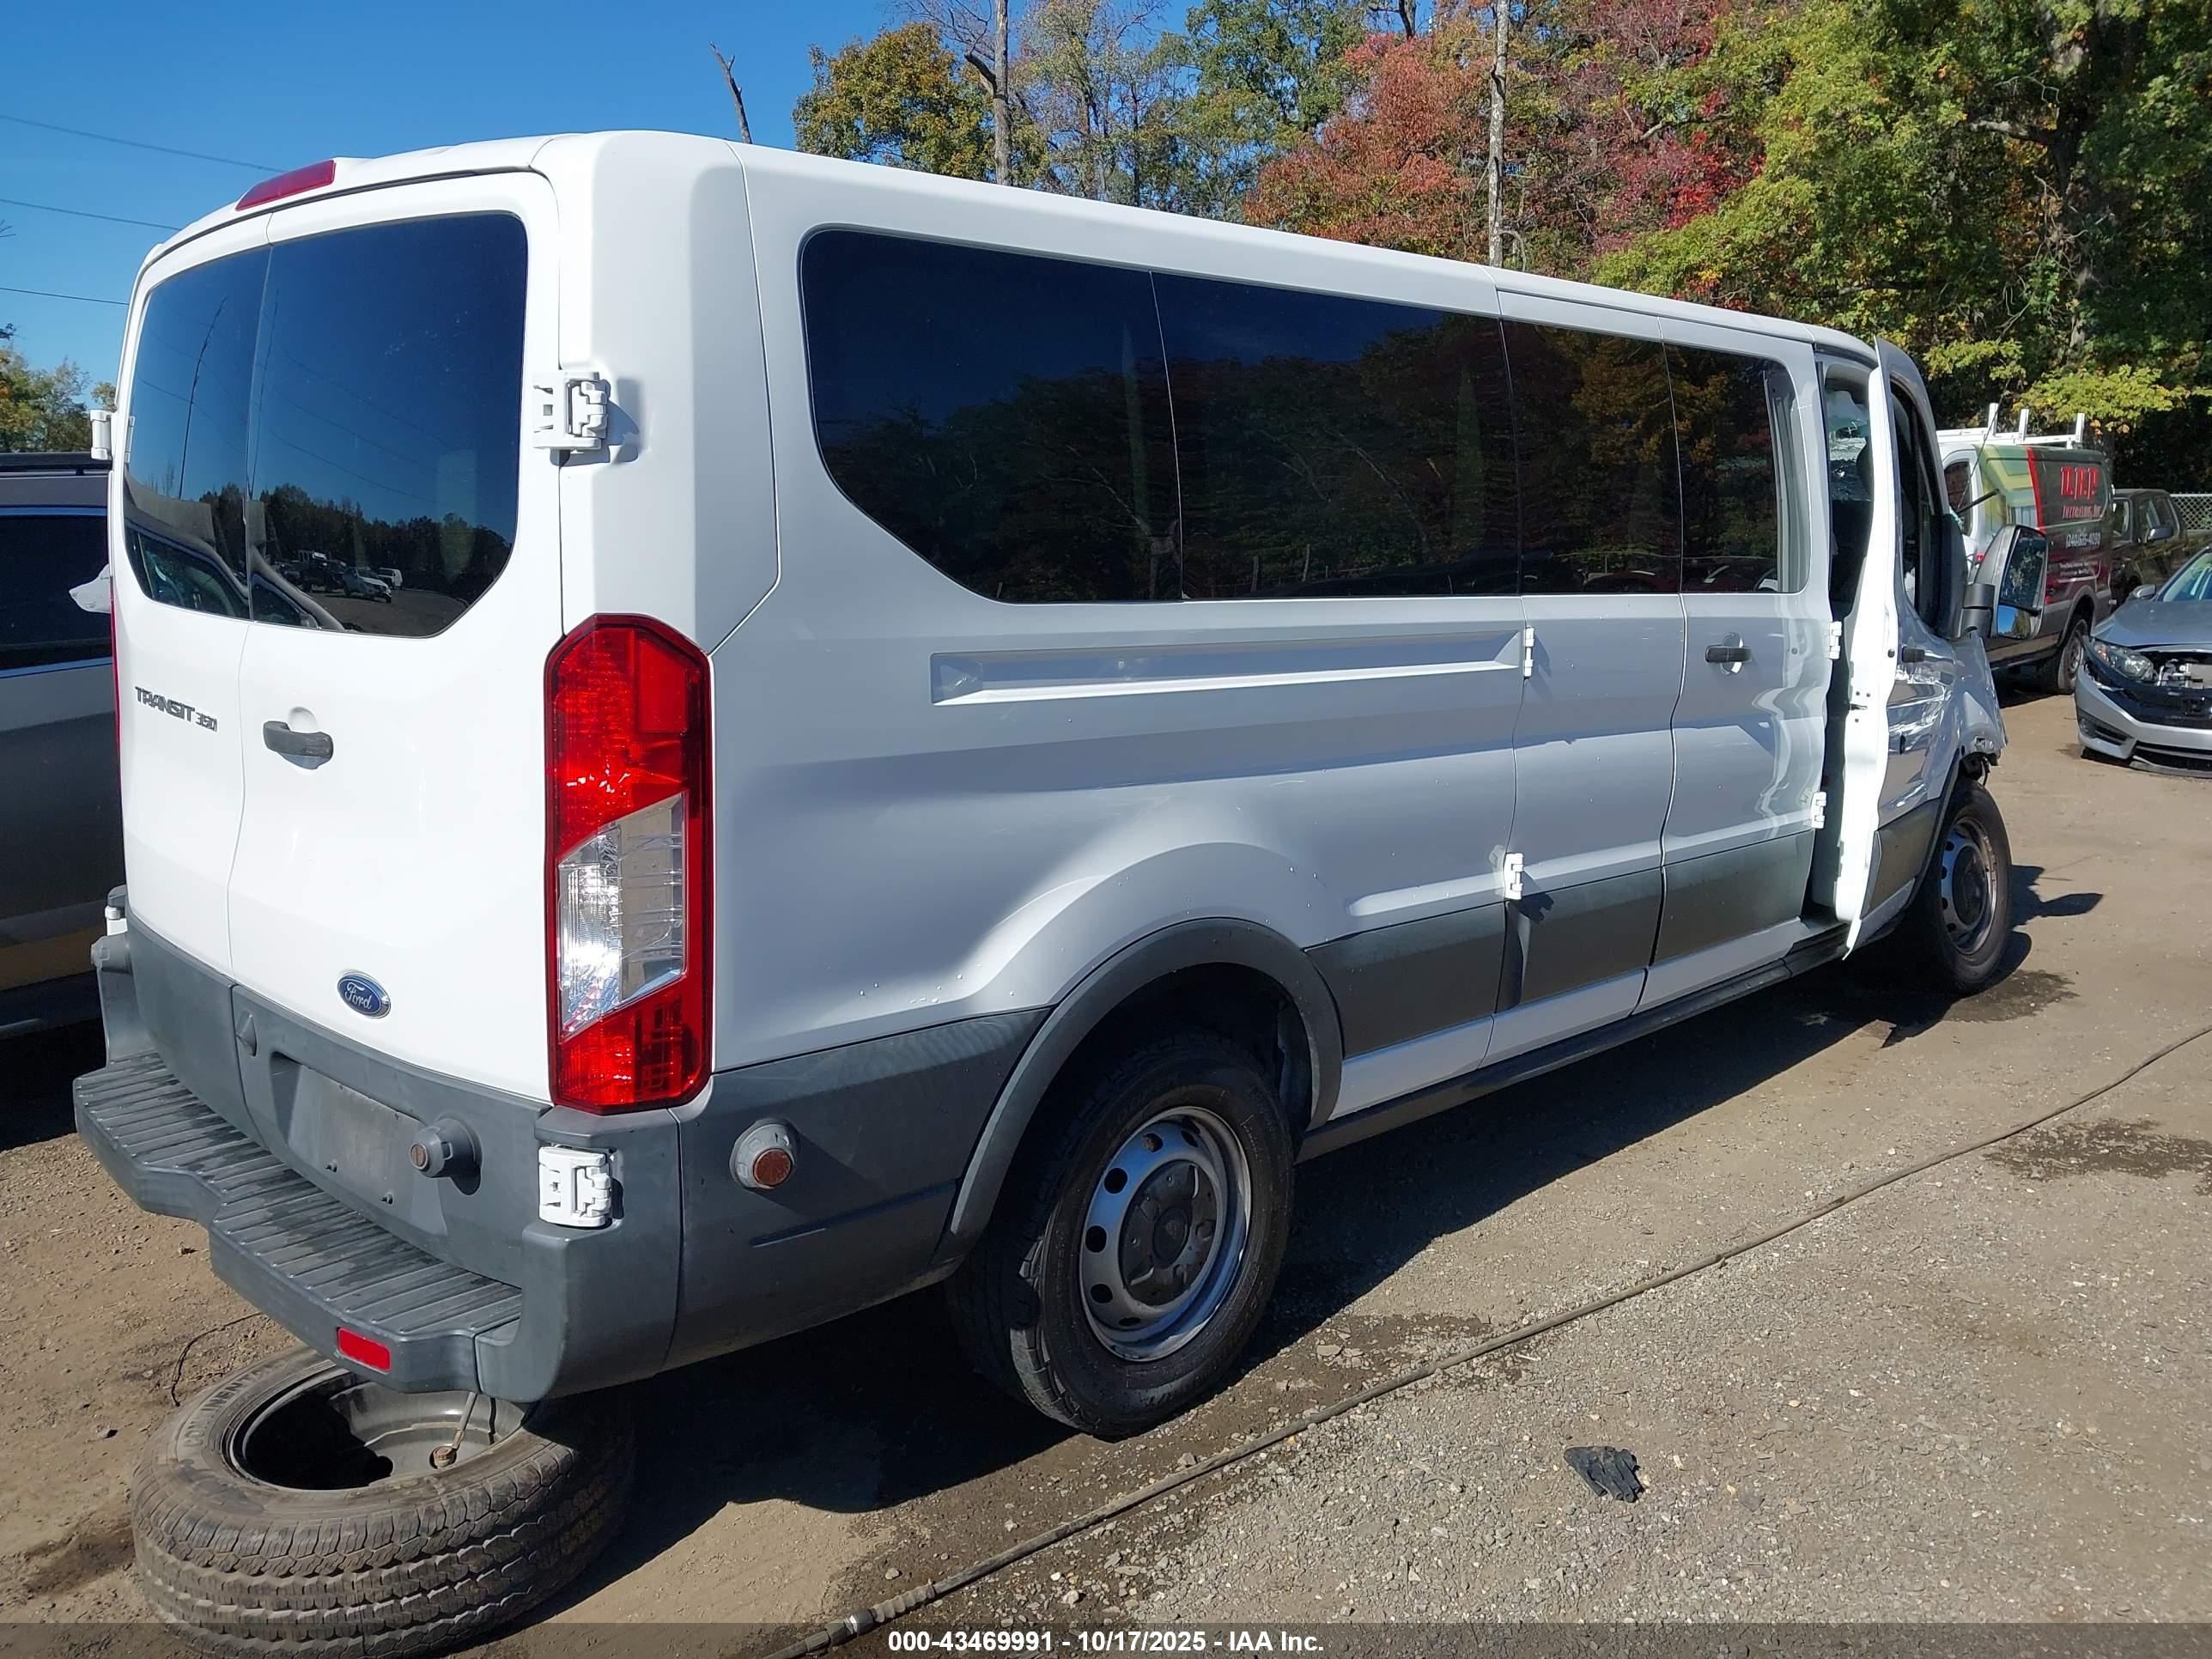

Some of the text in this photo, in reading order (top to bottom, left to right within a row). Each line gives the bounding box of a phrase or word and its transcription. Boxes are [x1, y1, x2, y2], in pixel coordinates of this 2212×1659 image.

[135, 686, 218, 732] TRANSIT 350
[344, 981, 373, 1010] Ford
